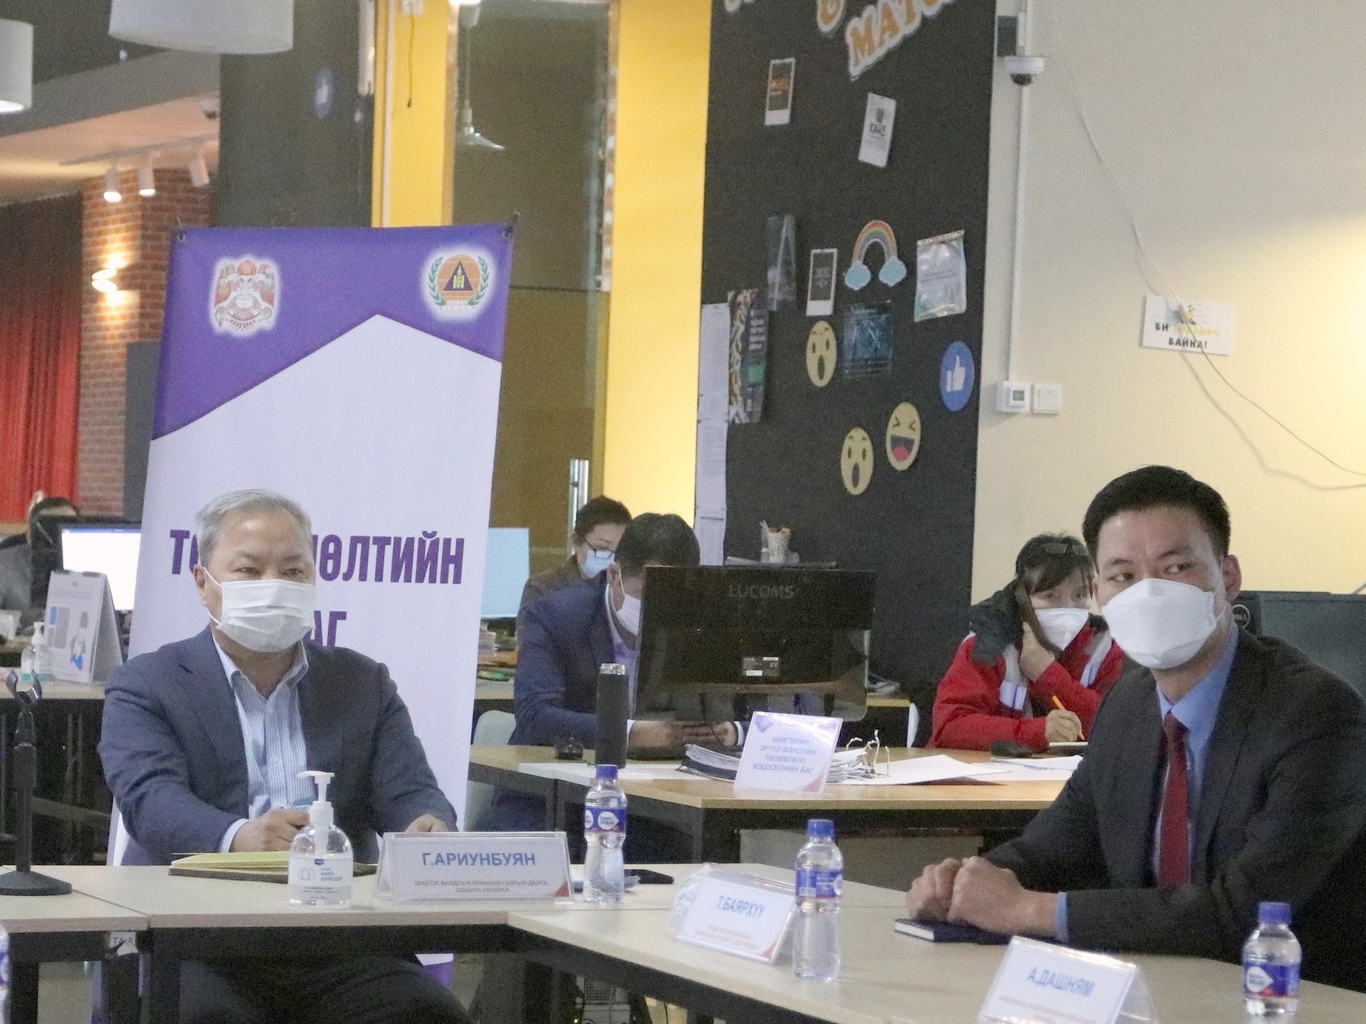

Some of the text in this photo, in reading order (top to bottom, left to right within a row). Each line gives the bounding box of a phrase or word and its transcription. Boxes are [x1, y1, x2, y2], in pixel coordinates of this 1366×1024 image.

[728, 584, 795, 599] LUCOMS
[303, 610, 347, 646] АГ
[421, 852, 536, 866] Г.АРИУНБУЯН
[1026, 966, 1095, 997] А.ДАШНЯМ
